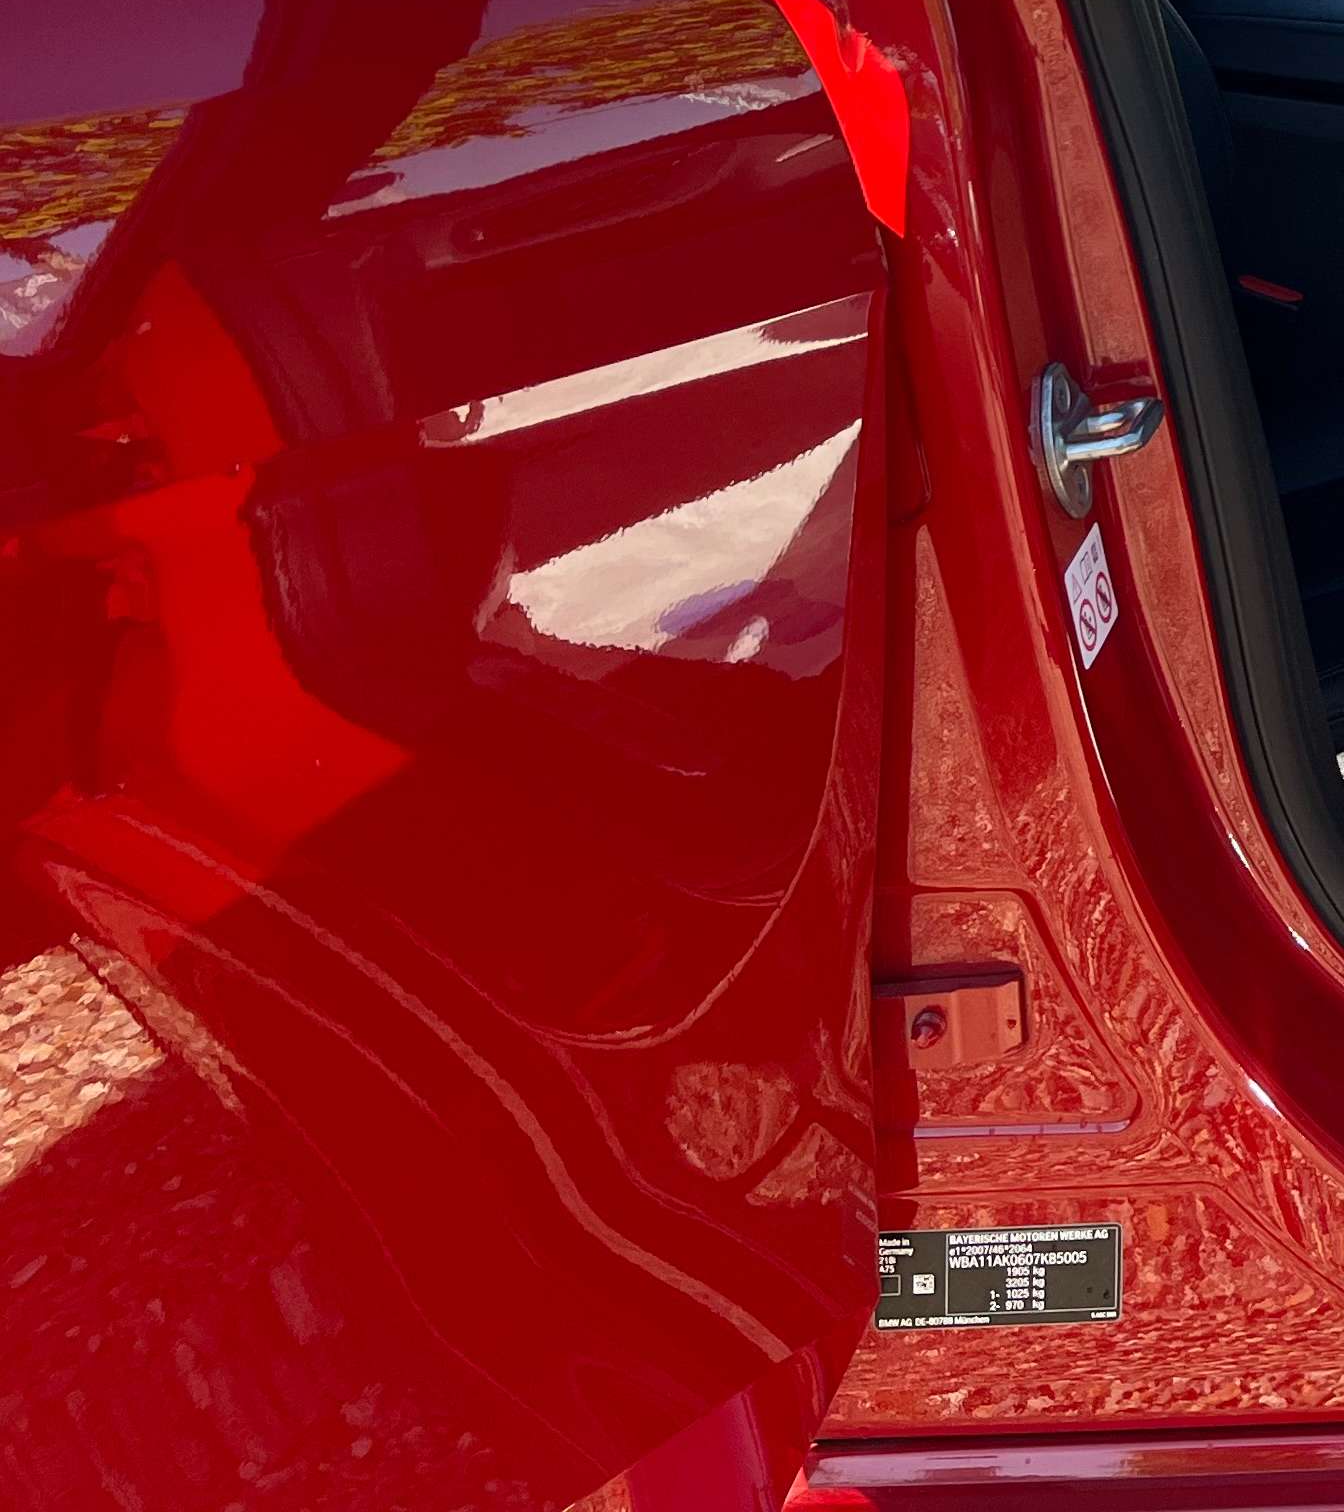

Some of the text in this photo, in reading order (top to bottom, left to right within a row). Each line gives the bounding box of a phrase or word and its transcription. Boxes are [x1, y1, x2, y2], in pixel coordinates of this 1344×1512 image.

[949, 1229, 1109, 1245] BAYERISCHE MOTOREN WERKE AG
[1032, 1265, 1046, 1277] kg
[1005, 1276, 1046, 1288] 3205 kg
[1006, 1288, 1030, 1299] 1025
[1032, 1287, 1045, 1299] kg
[1005, 1300, 1025, 1311] 970
[1032, 1299, 1045, 1311] kg
